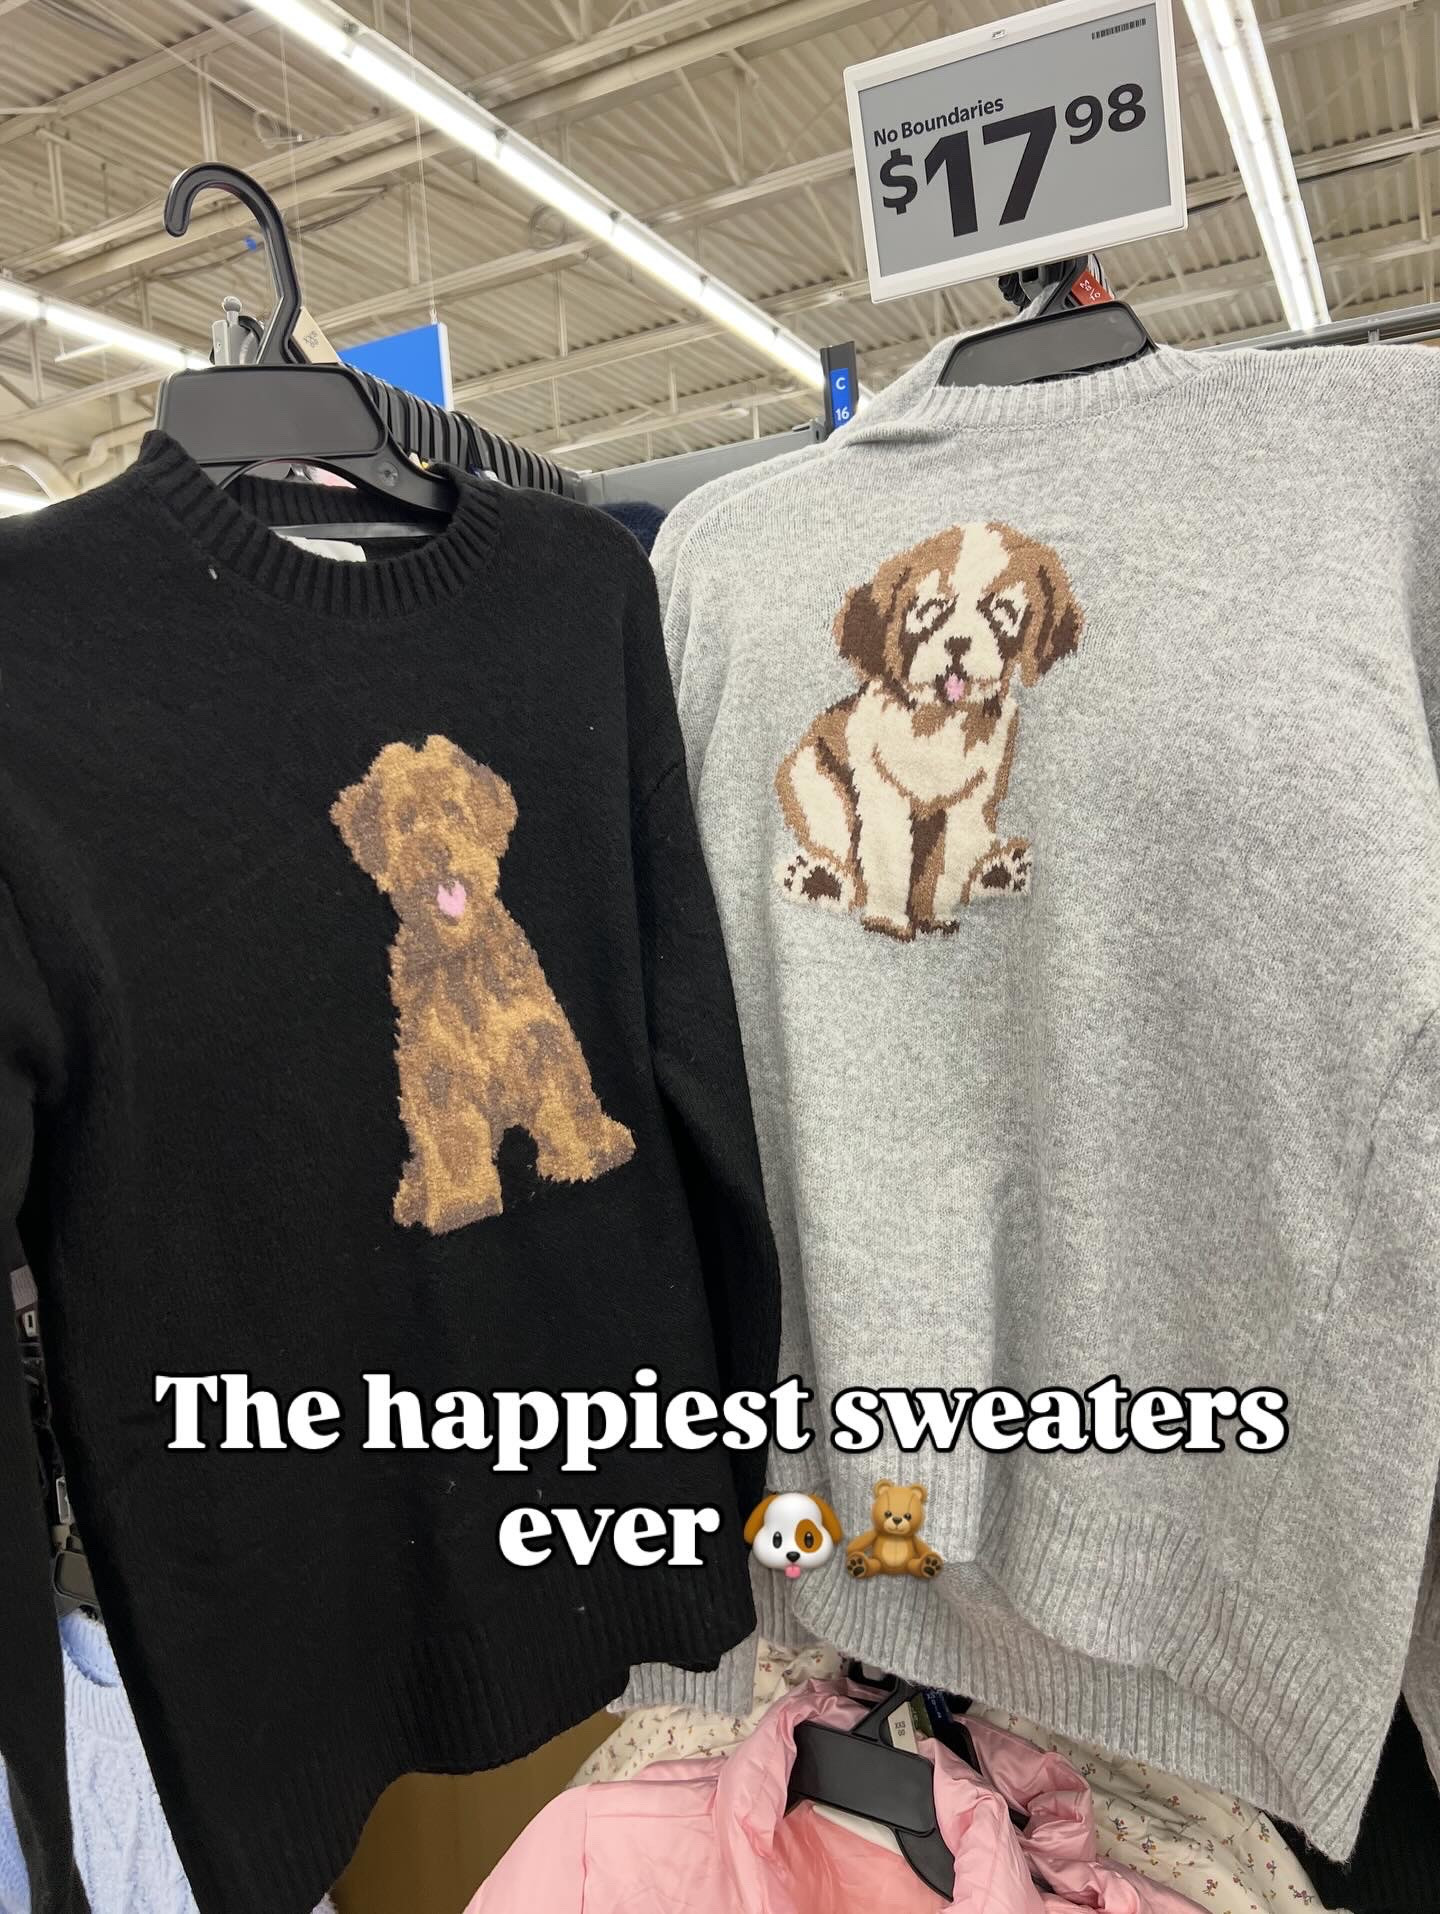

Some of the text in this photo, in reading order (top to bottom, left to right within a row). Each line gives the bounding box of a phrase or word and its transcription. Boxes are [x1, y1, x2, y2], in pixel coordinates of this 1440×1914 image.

[873, 98, 1004, 147] No Boundaries
[835, 376, 847, 391] C
[835, 406, 850, 421] 16
